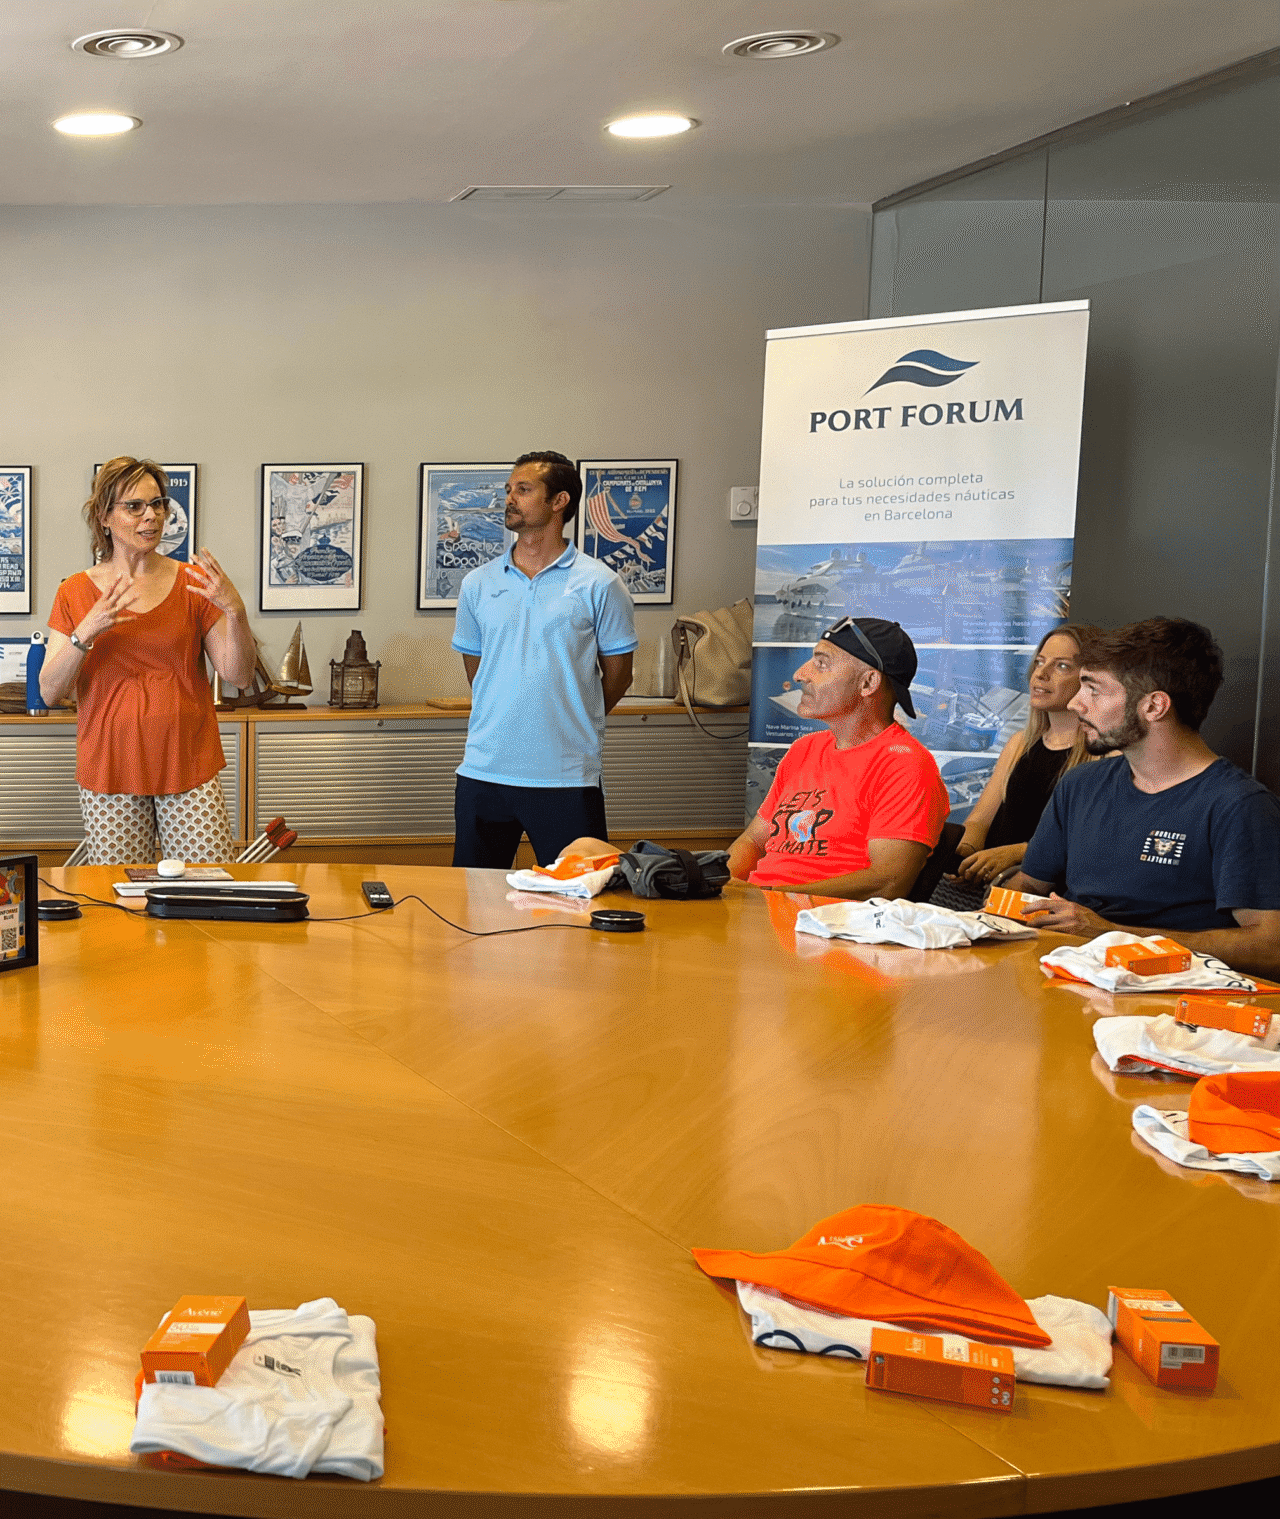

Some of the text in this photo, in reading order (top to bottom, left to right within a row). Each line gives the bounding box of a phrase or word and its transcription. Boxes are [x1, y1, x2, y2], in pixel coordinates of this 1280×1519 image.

[809, 398, 1024, 434] PORT FORUM
[170, 478, 188, 487] 1915
[839, 472, 983, 489] La solución completa
[809, 487, 1016, 509] para tus necesidades náuticas
[864, 508, 953, 522] en Barcelona
[443, 552, 491, 570] Regata
